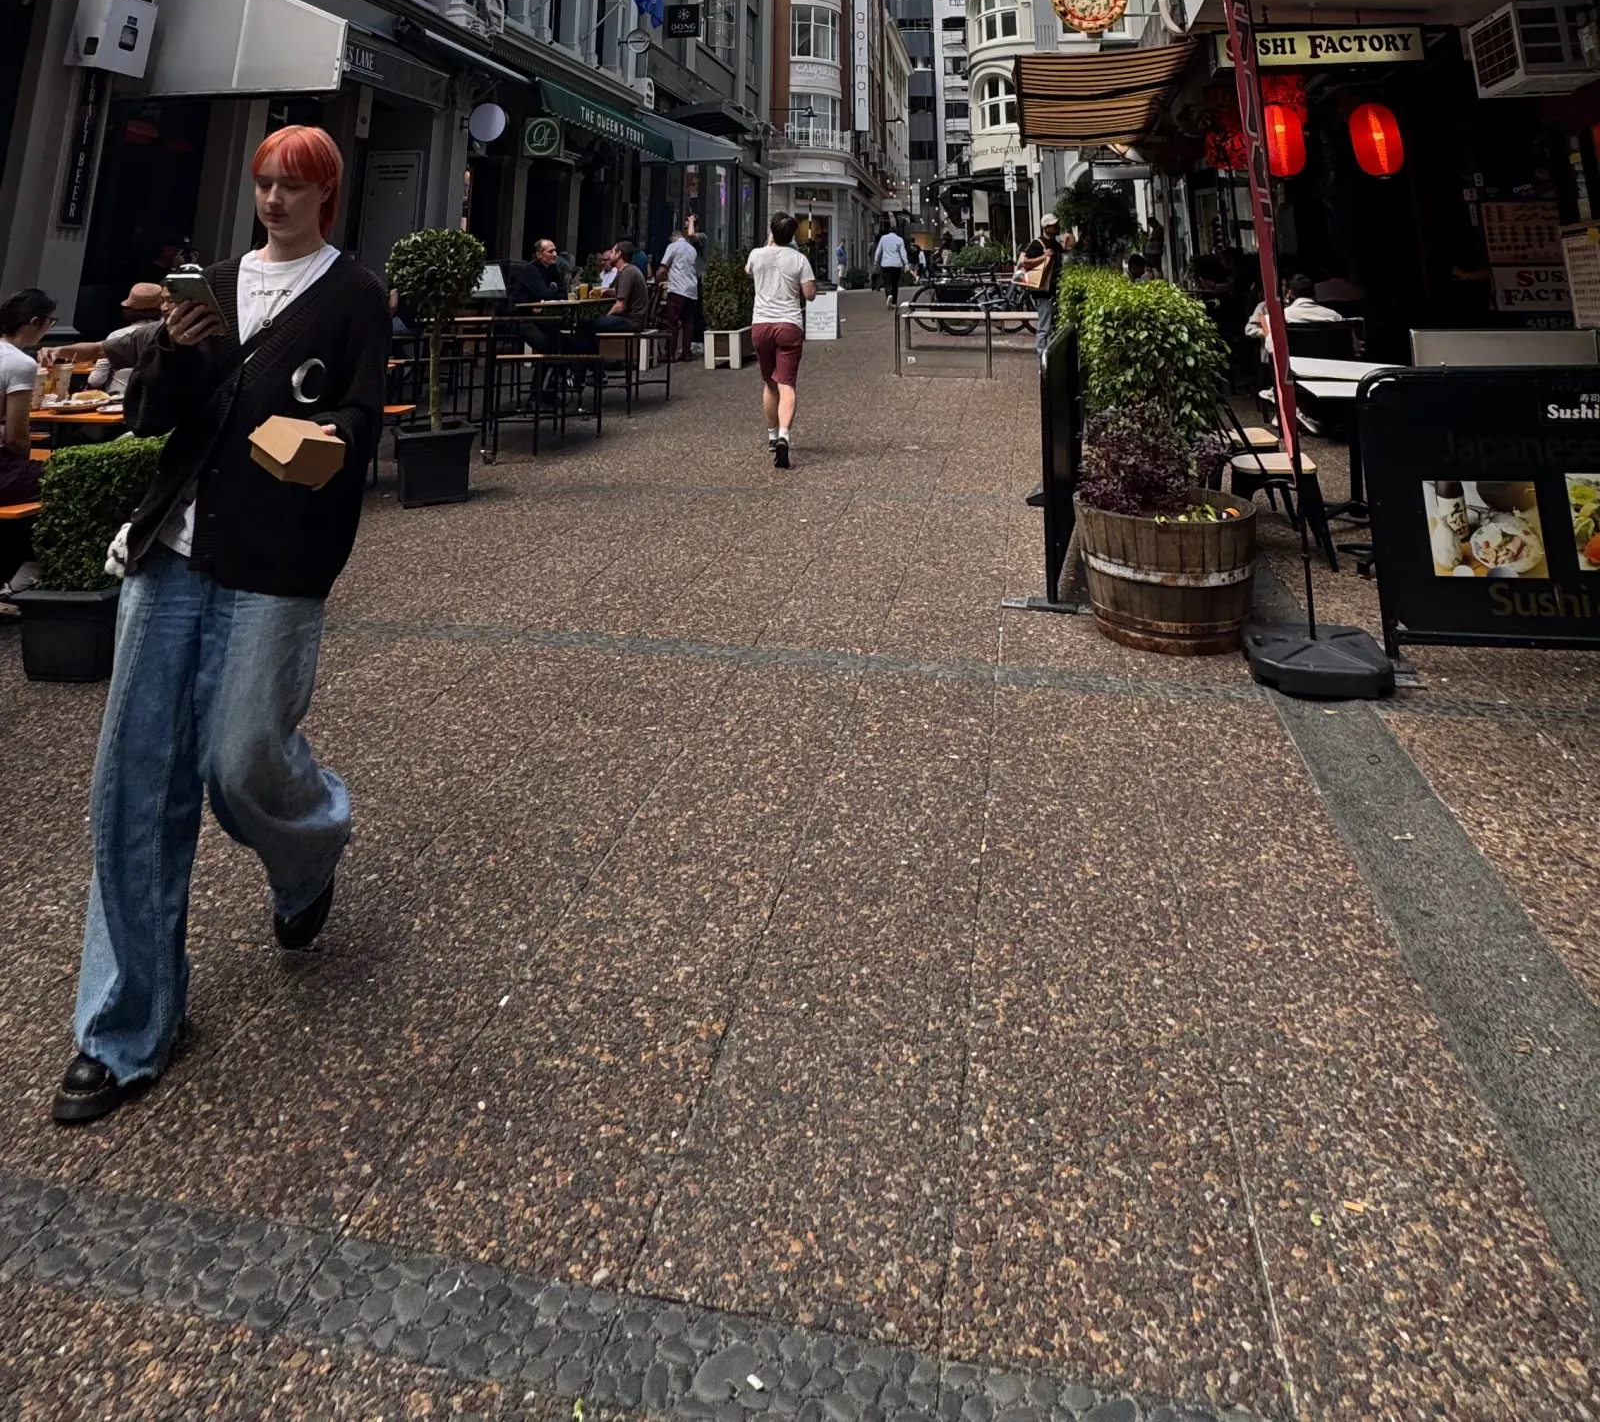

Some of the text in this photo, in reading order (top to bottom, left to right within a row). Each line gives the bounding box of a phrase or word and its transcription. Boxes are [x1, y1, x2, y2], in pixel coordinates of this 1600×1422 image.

[671, 23, 696, 31] DONG
[1226, 33, 1412, 62] SSHI FACTORY
[355, 48, 375, 71] LANE
[856, 12, 867, 107] gorman
[581, 105, 595, 124] THE
[626, 126, 645, 146] FERRY
[68, 74, 98, 218] CRAFT BEER
[1516, 270, 1568, 287] SUS
[250, 288, 293, 297] KINETIC
[1503, 288, 1571, 306] FACT
[1546, 403, 1600, 420] Sushi
[1488, 582, 1592, 619] Sushi
